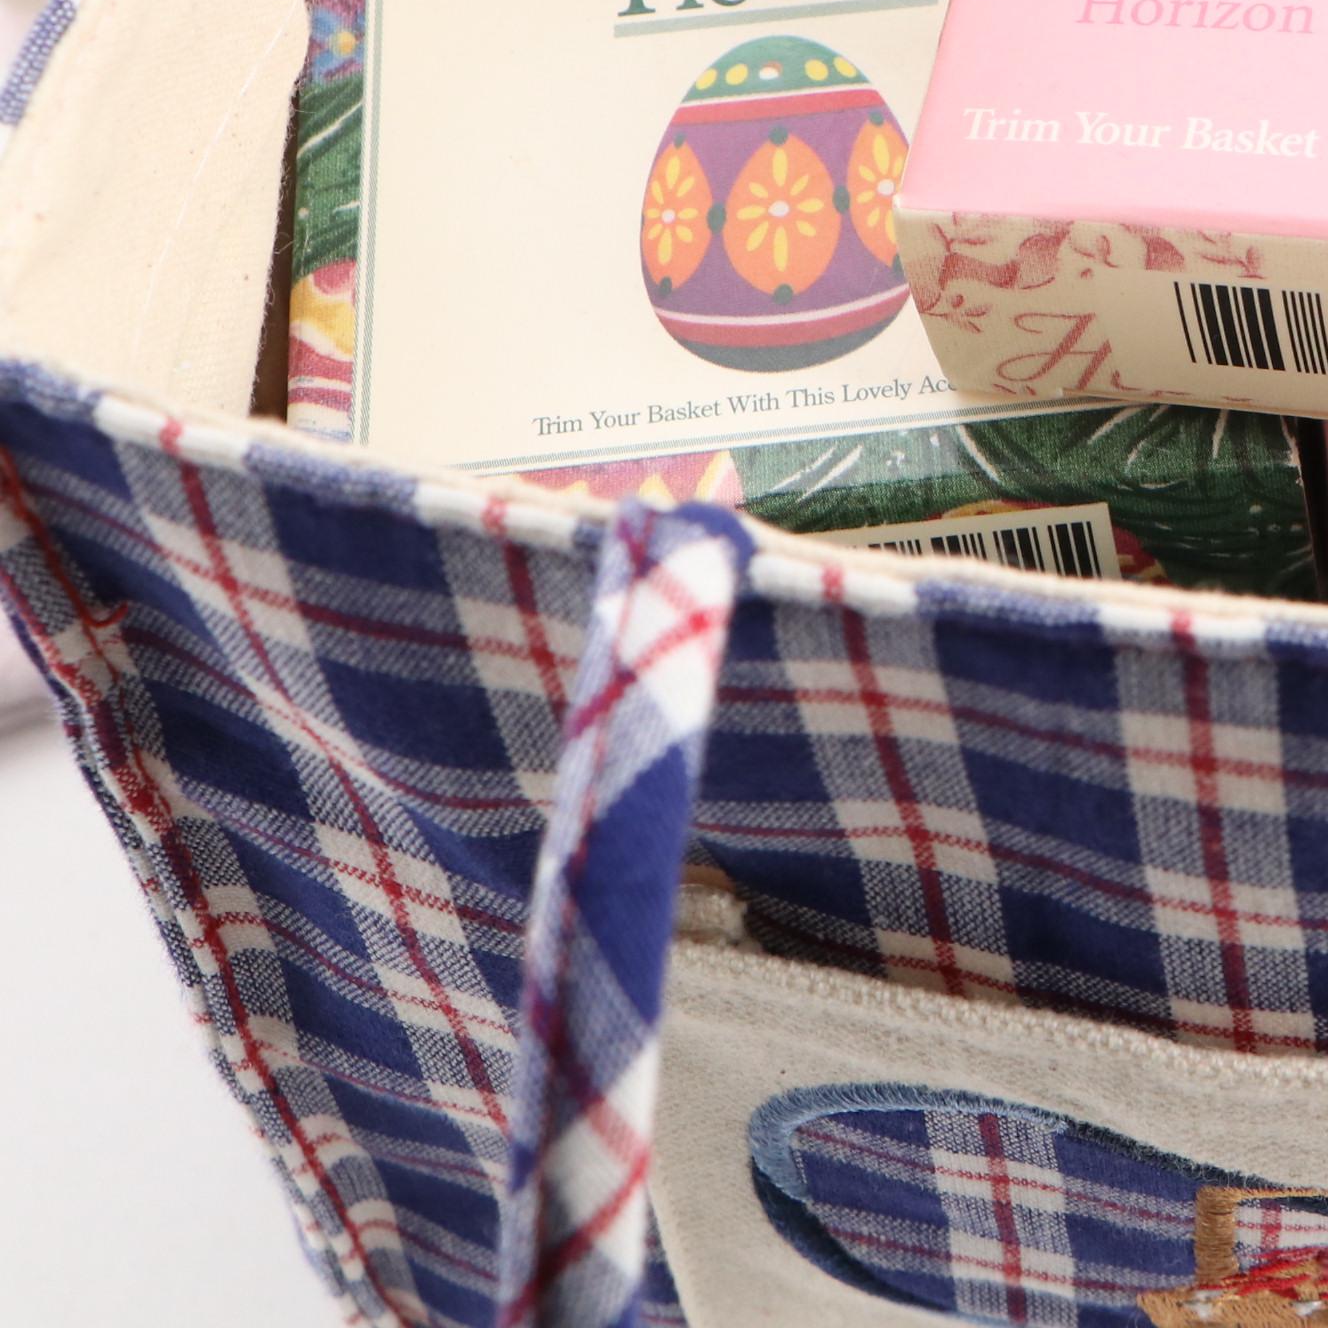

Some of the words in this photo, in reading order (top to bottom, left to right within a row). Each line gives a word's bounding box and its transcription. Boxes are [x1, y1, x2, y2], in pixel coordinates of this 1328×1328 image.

[963, 108, 1060, 142] Trim
[1075, 112, 1171, 147] Your
[1183, 117, 1319, 159] Basket
[532, 416, 583, 436] Trim
[590, 410, 641, 430] Your
[648, 399, 721, 423] Basket
[727, 394, 780, 416] With
[785, 387, 836, 408] This
[842, 378, 912, 403] Lovely
